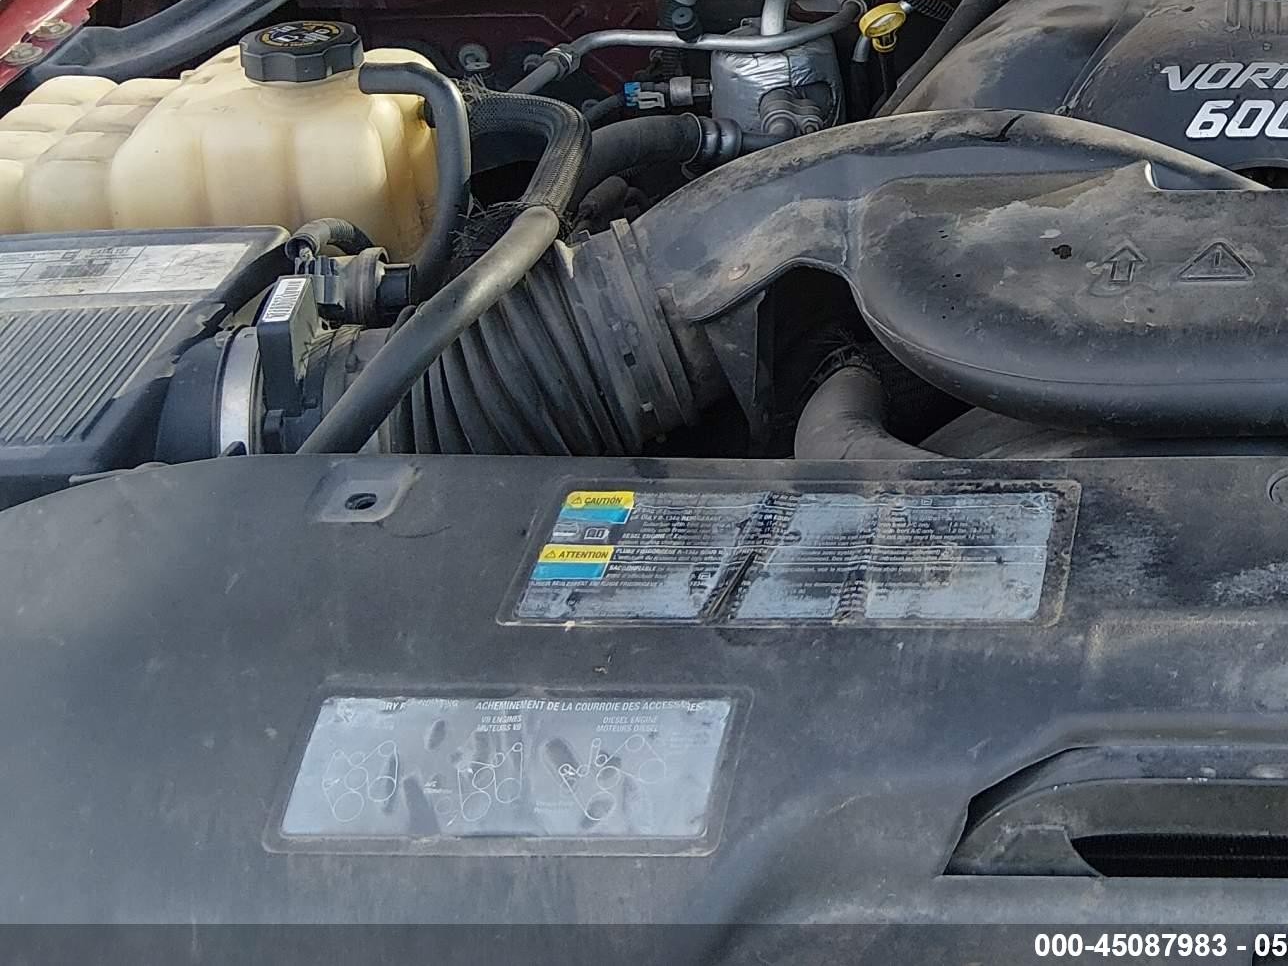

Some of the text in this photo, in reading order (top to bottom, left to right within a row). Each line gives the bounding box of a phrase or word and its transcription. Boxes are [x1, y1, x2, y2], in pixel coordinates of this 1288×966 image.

[584, 496, 624, 505] CAUTION
[558, 550, 609, 559] ATTENTION
[475, 699, 546, 711] ACHEMINEMENT
[547, 701, 560, 712] DE
[561, 702, 573, 712] LA
[574, 702, 621, 712] COURROIE
[622, 701, 641, 712] DES
[602, 716, 629, 724] DIESEL
